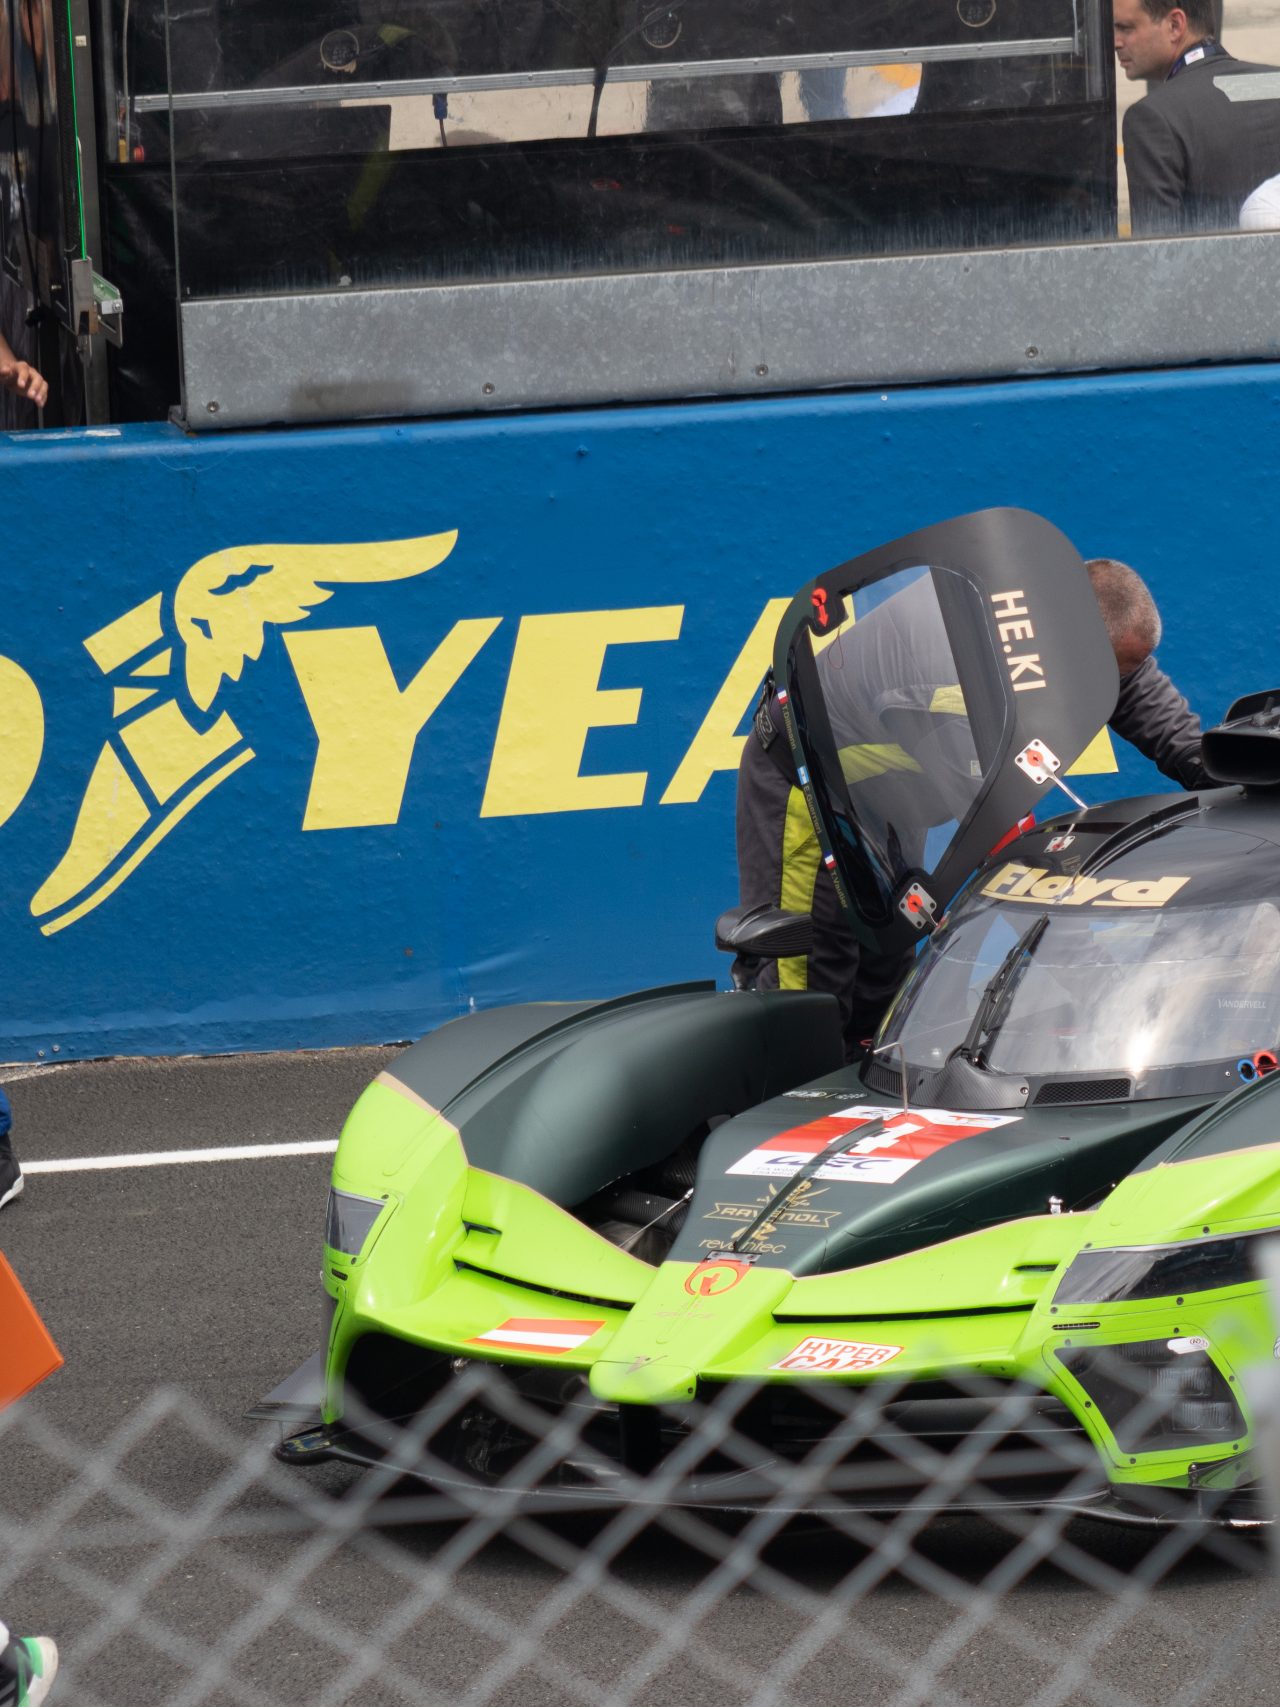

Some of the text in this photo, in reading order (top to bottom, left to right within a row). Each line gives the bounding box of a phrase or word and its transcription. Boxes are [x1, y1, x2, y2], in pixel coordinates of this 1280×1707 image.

[991, 590, 1046, 691] HE.KI
[981, 862, 1191, 907] Floyd
[780, 1355, 874, 1370] CAR
[799, 1341, 890, 1360] HYPER
